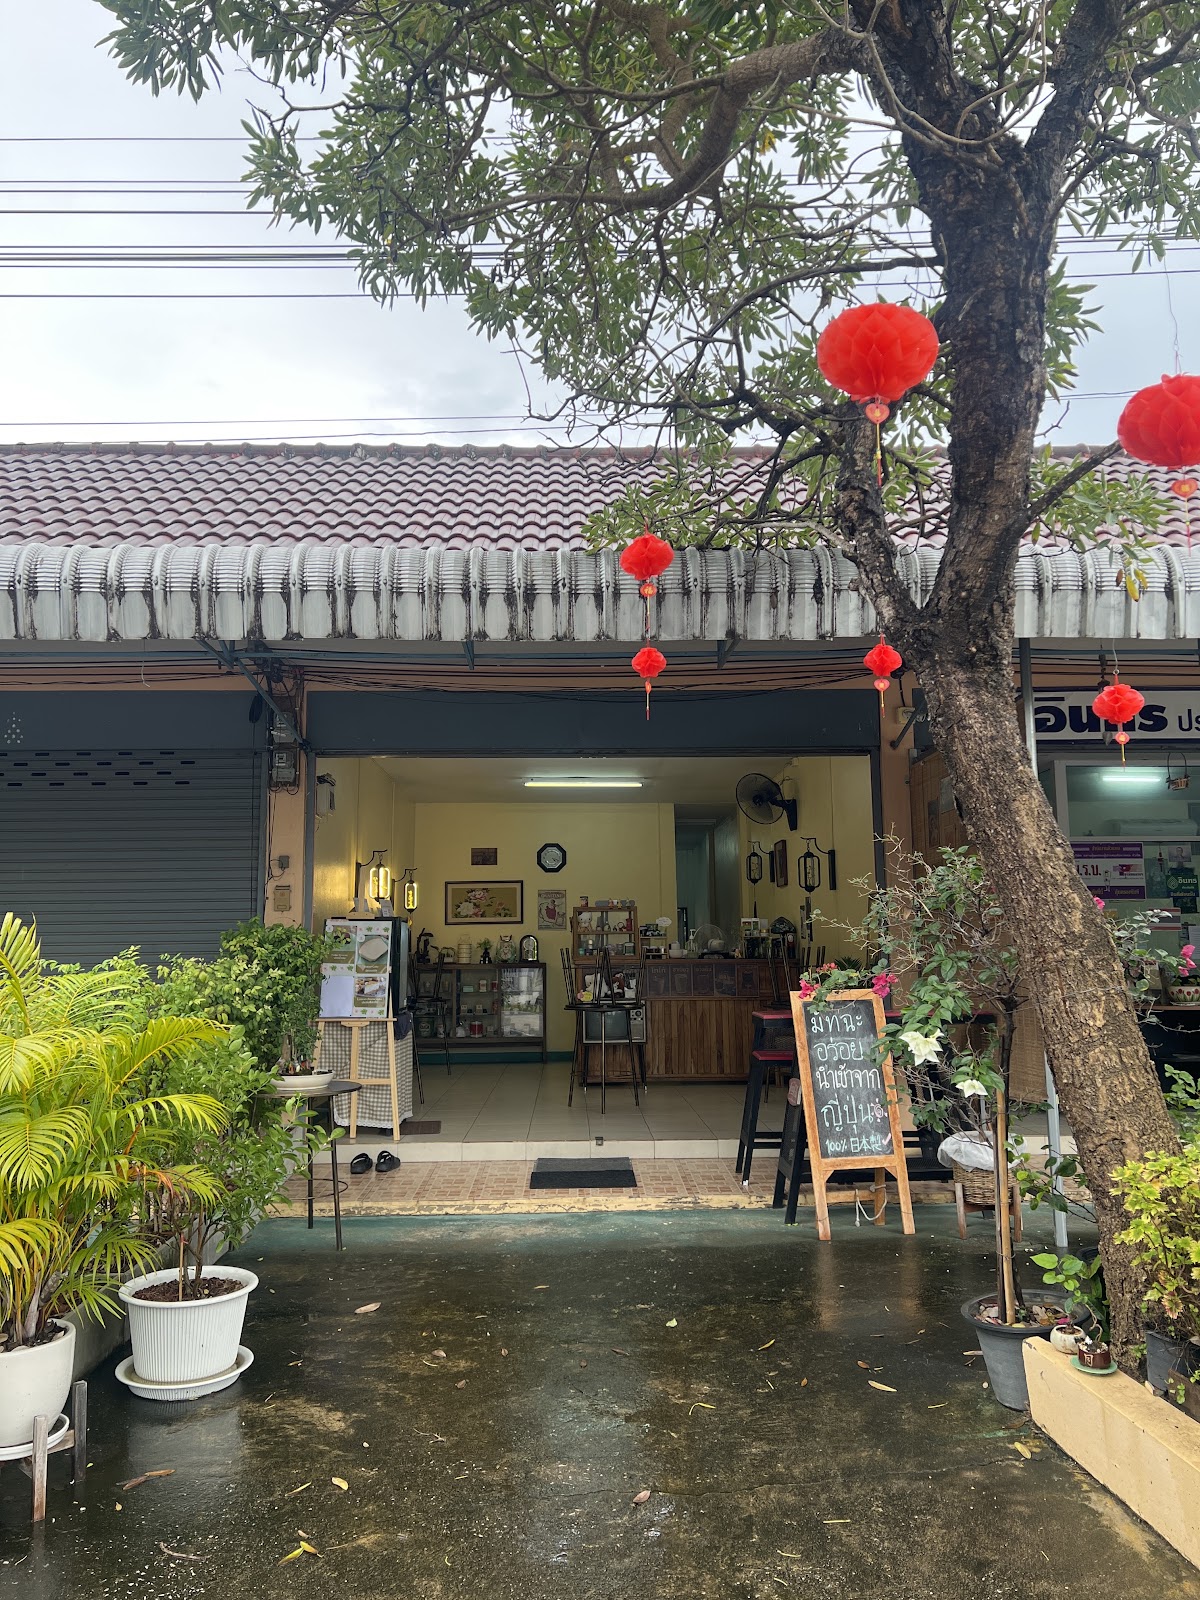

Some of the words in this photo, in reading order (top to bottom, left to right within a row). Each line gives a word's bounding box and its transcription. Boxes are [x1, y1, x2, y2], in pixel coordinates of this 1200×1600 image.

[813, 1037, 863, 1061] อร่อย
[816, 1063, 881, 1089] นำเข้าจาก
[821, 1093, 874, 1134] ญี่ปุ่น
[825, 1139, 848, 1155] 100%
